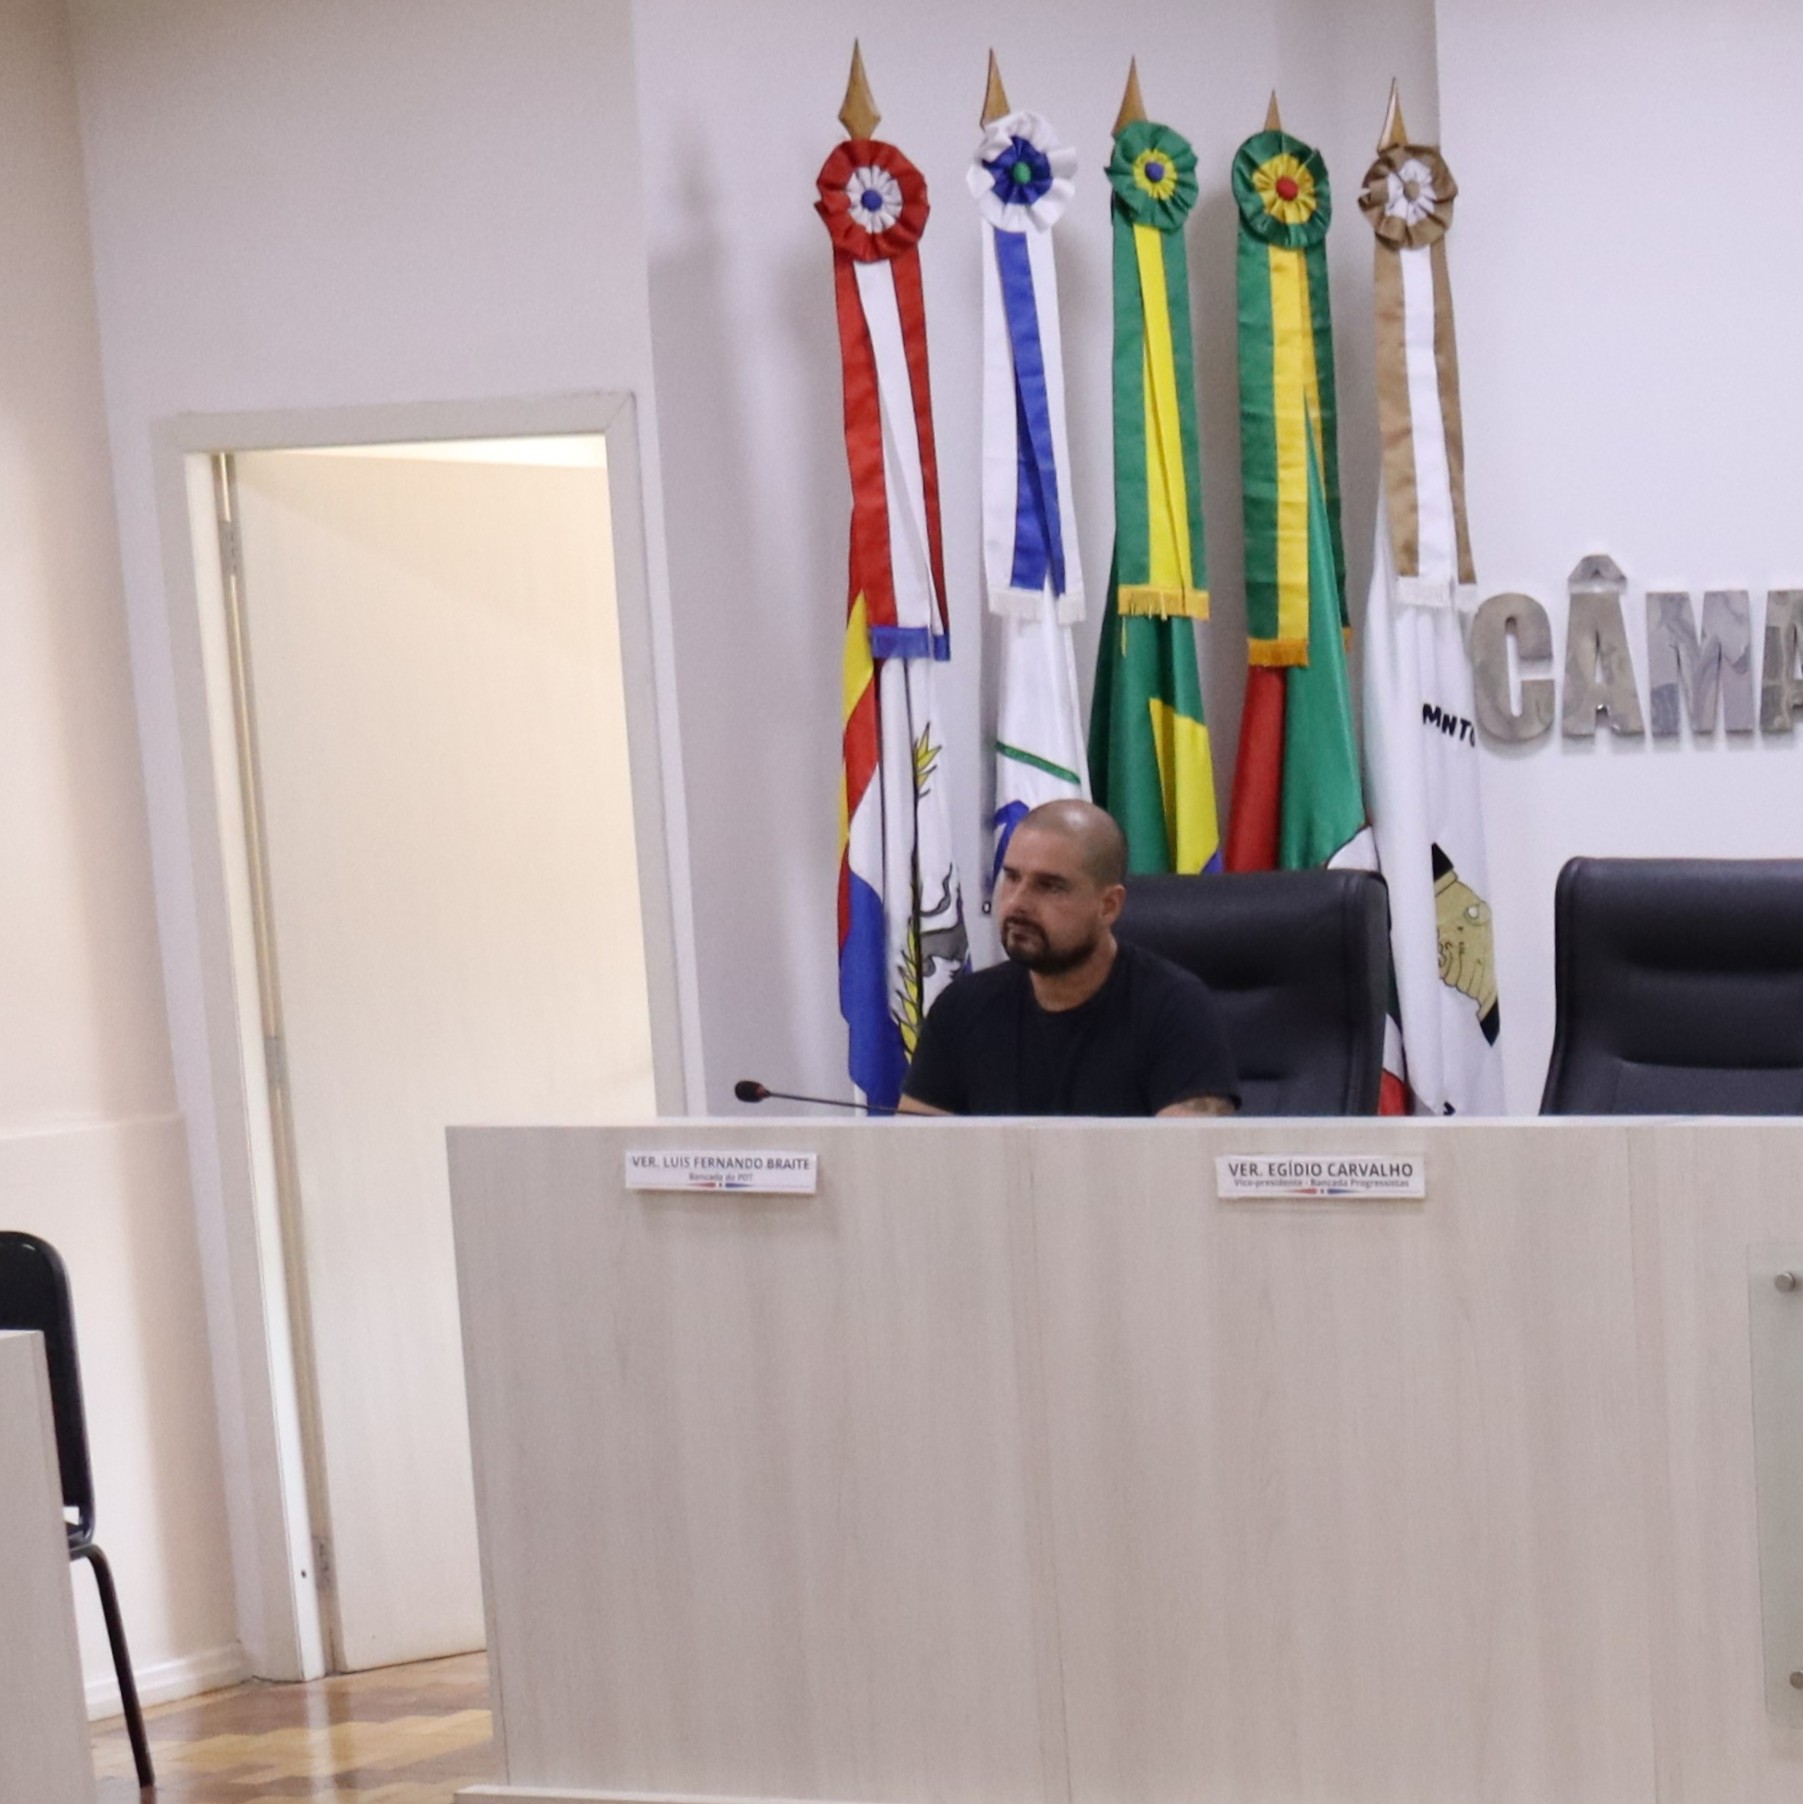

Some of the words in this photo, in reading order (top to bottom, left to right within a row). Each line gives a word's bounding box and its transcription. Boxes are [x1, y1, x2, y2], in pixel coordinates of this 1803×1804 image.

[632, 1156, 660, 1169] VER.
[663, 1157, 690, 1169] LUIS
[694, 1158, 763, 1170] FERNANDO
[767, 1158, 810, 1171] BRAITE
[1229, 1163, 1264, 1177] VER.
[1268, 1160, 1322, 1177] EGÍDIO
[1328, 1162, 1413, 1177] CARVALHO
